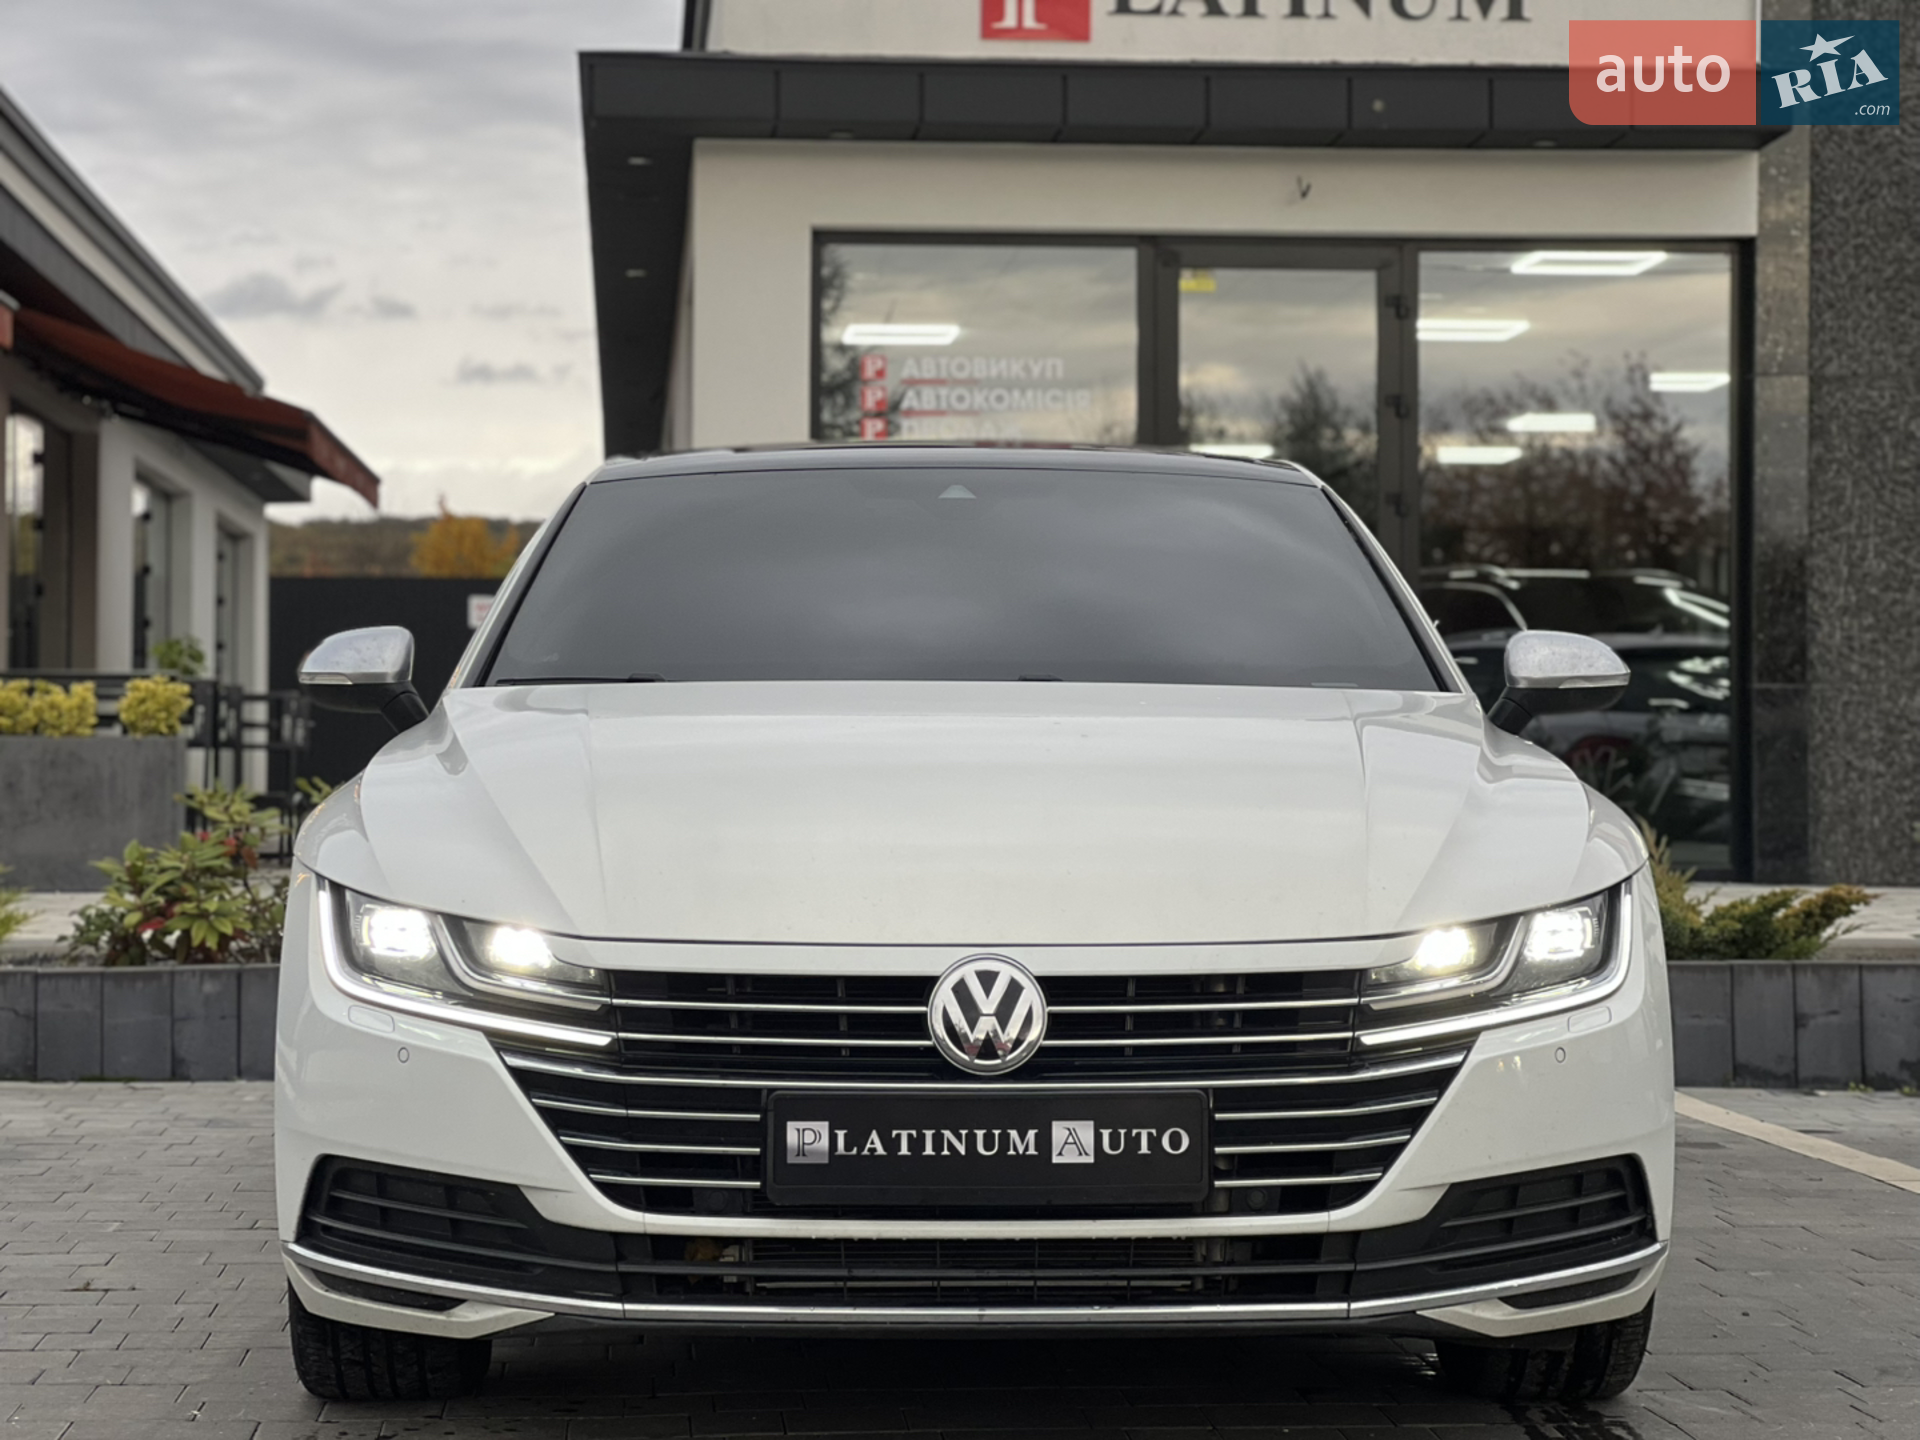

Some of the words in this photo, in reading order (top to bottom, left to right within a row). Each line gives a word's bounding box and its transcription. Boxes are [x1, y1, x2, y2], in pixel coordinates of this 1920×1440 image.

[900, 357, 1064, 379] АВТОВИКУП
[793, 1126, 1040, 1158] PLATINUM
[1055, 1126, 1190, 1158] AUTO
